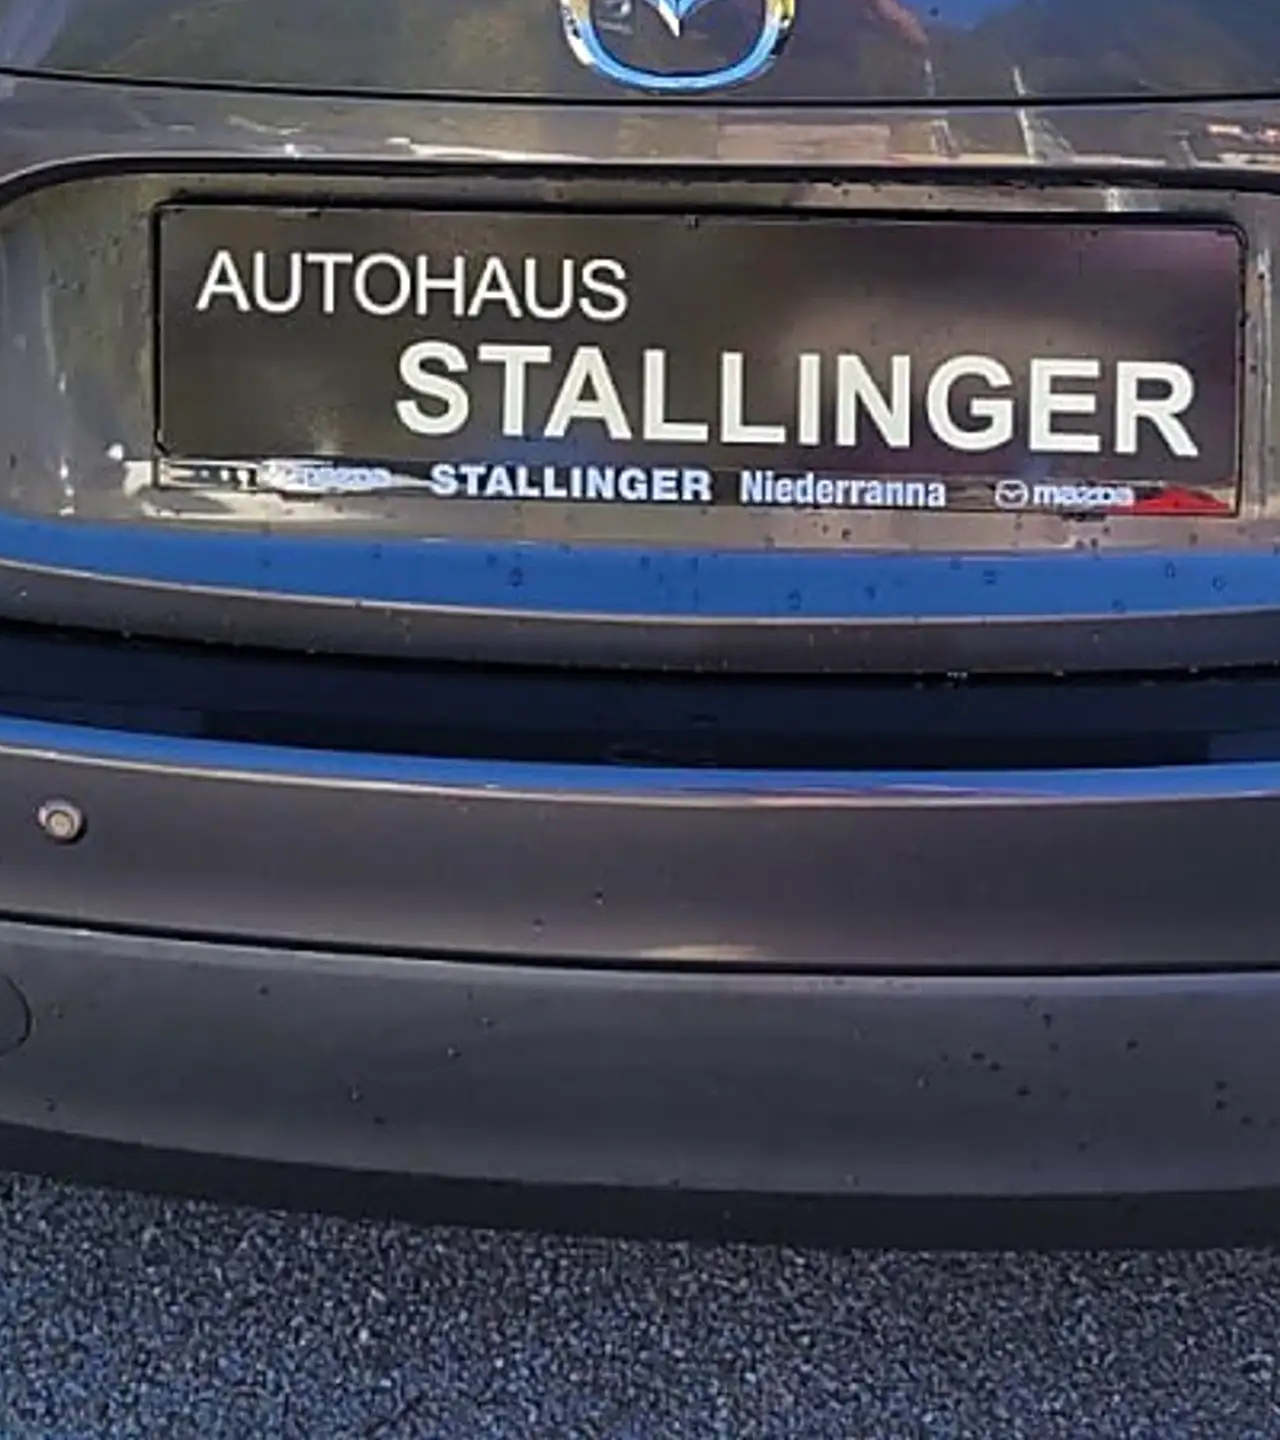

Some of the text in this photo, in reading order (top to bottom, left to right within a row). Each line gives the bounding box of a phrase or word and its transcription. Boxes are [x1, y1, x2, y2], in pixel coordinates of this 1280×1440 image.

[195, 249, 629, 321] AUTOHAUS
[395, 339, 1199, 457] STALLINGER
[430, 462, 713, 502] STALLINGER
[740, 469, 947, 507] Niederranna
[1033, 482, 1136, 507] mazda
